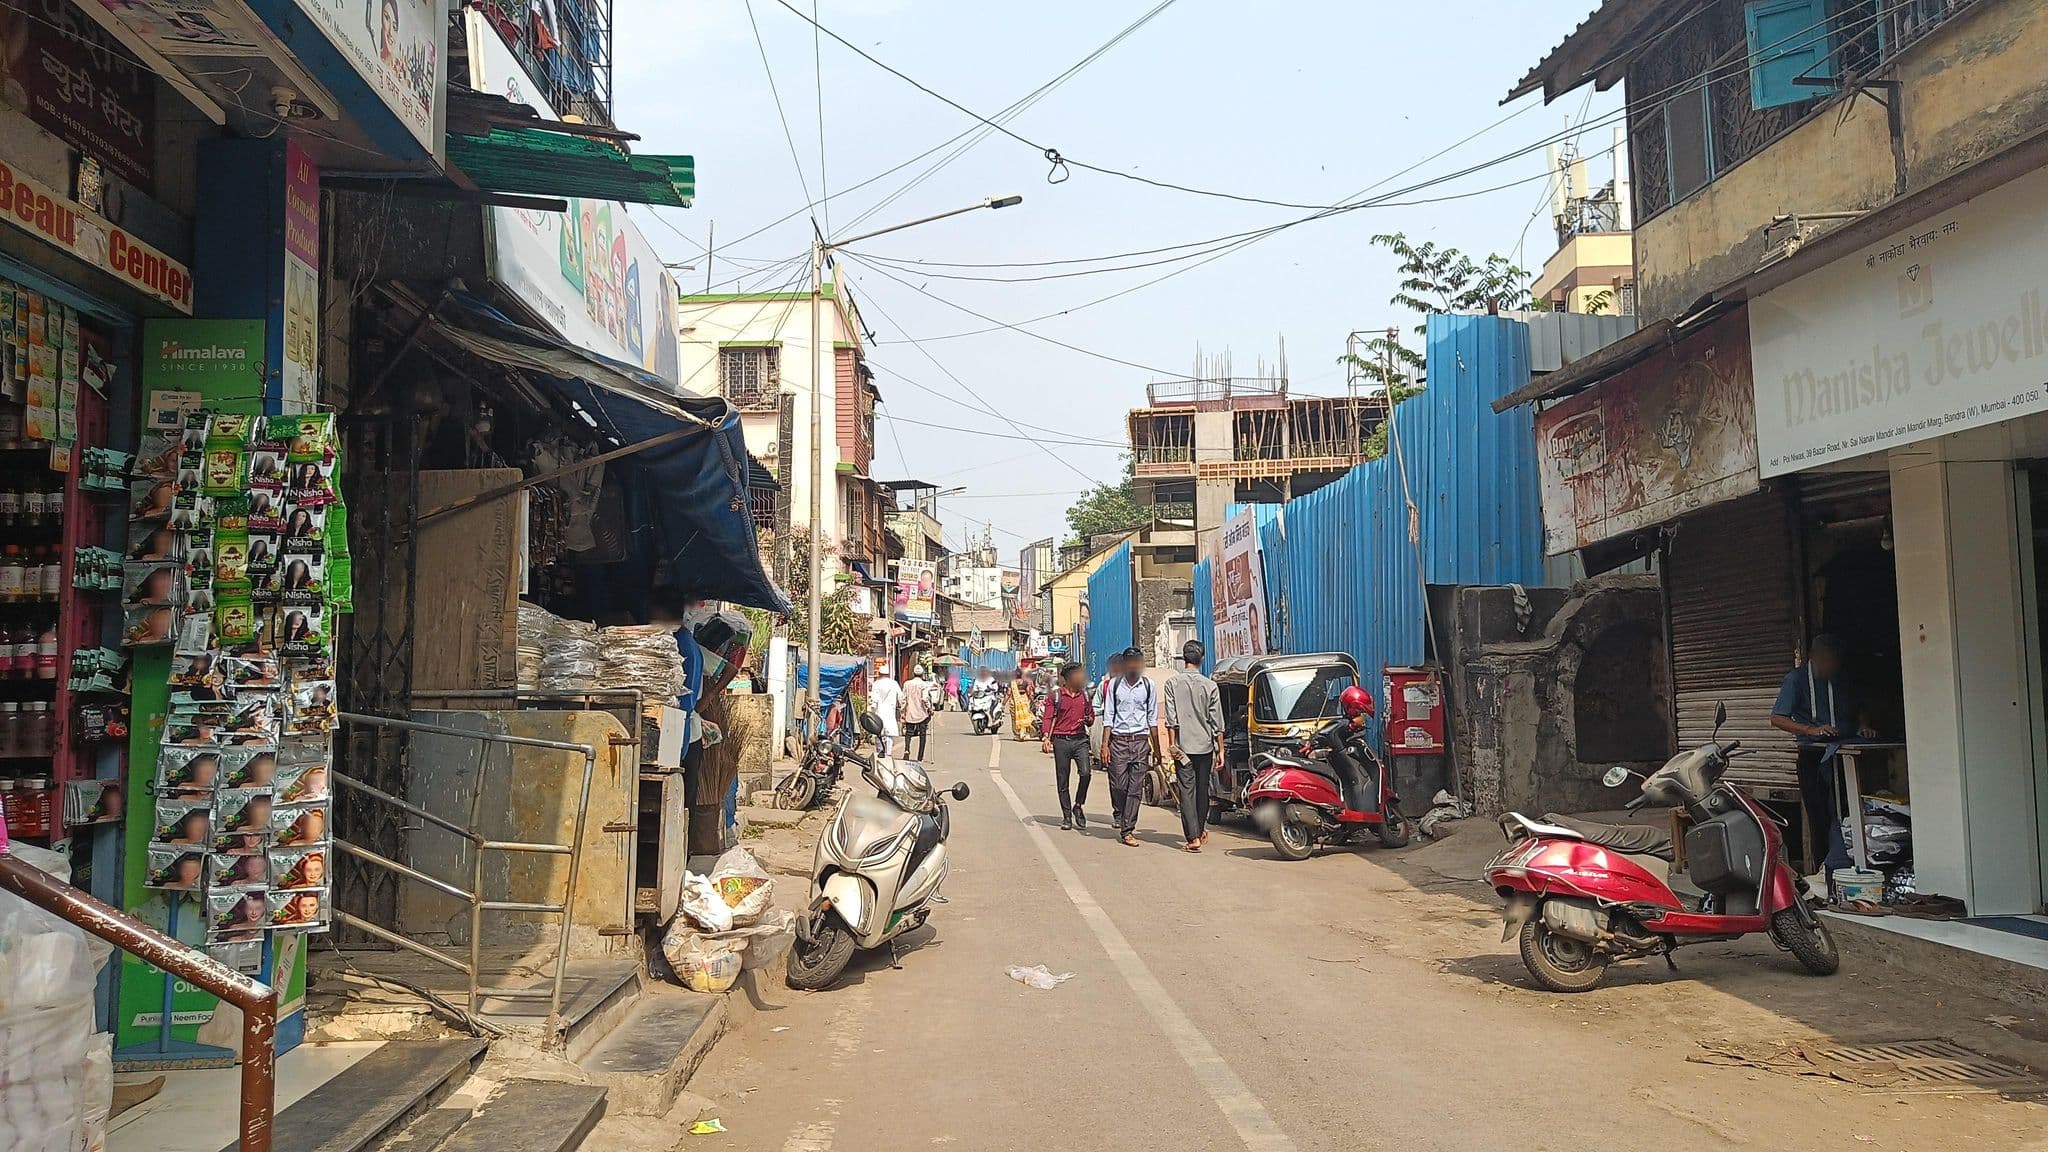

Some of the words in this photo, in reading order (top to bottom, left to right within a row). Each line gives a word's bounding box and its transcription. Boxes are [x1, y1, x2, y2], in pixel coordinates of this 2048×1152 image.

[297, 159, 309, 185] All
[287, 184, 317, 225] Cosmetic
[0, 161, 75, 247] Beau
[108, 229, 193, 306] Center
[287, 217, 317, 257] Products
[161, 340, 246, 359] Himalaya
[161, 363, 205, 372] SINCE
[214, 363, 246, 371] 1930
[1782, 344, 1912, 429] Manisha
[1907, 421, 1926, 434] Mandir
[1944, 411, 1966, 424] Bandra
[1981, 398, 2007, 414] Mumbai
[2012, 394, 2023, 406] 400
[254, 476, 274, 484] Nisha
[298, 489, 324, 498] Nisha
[248, 514, 269, 522] Nisha
[287, 538, 313, 547] Nisha
[251, 590, 272, 598] Nisha
[285, 590, 312, 600] Nisha
[283, 642, 309, 652] Nisha
[197, 1013, 212, 1021] Fac
